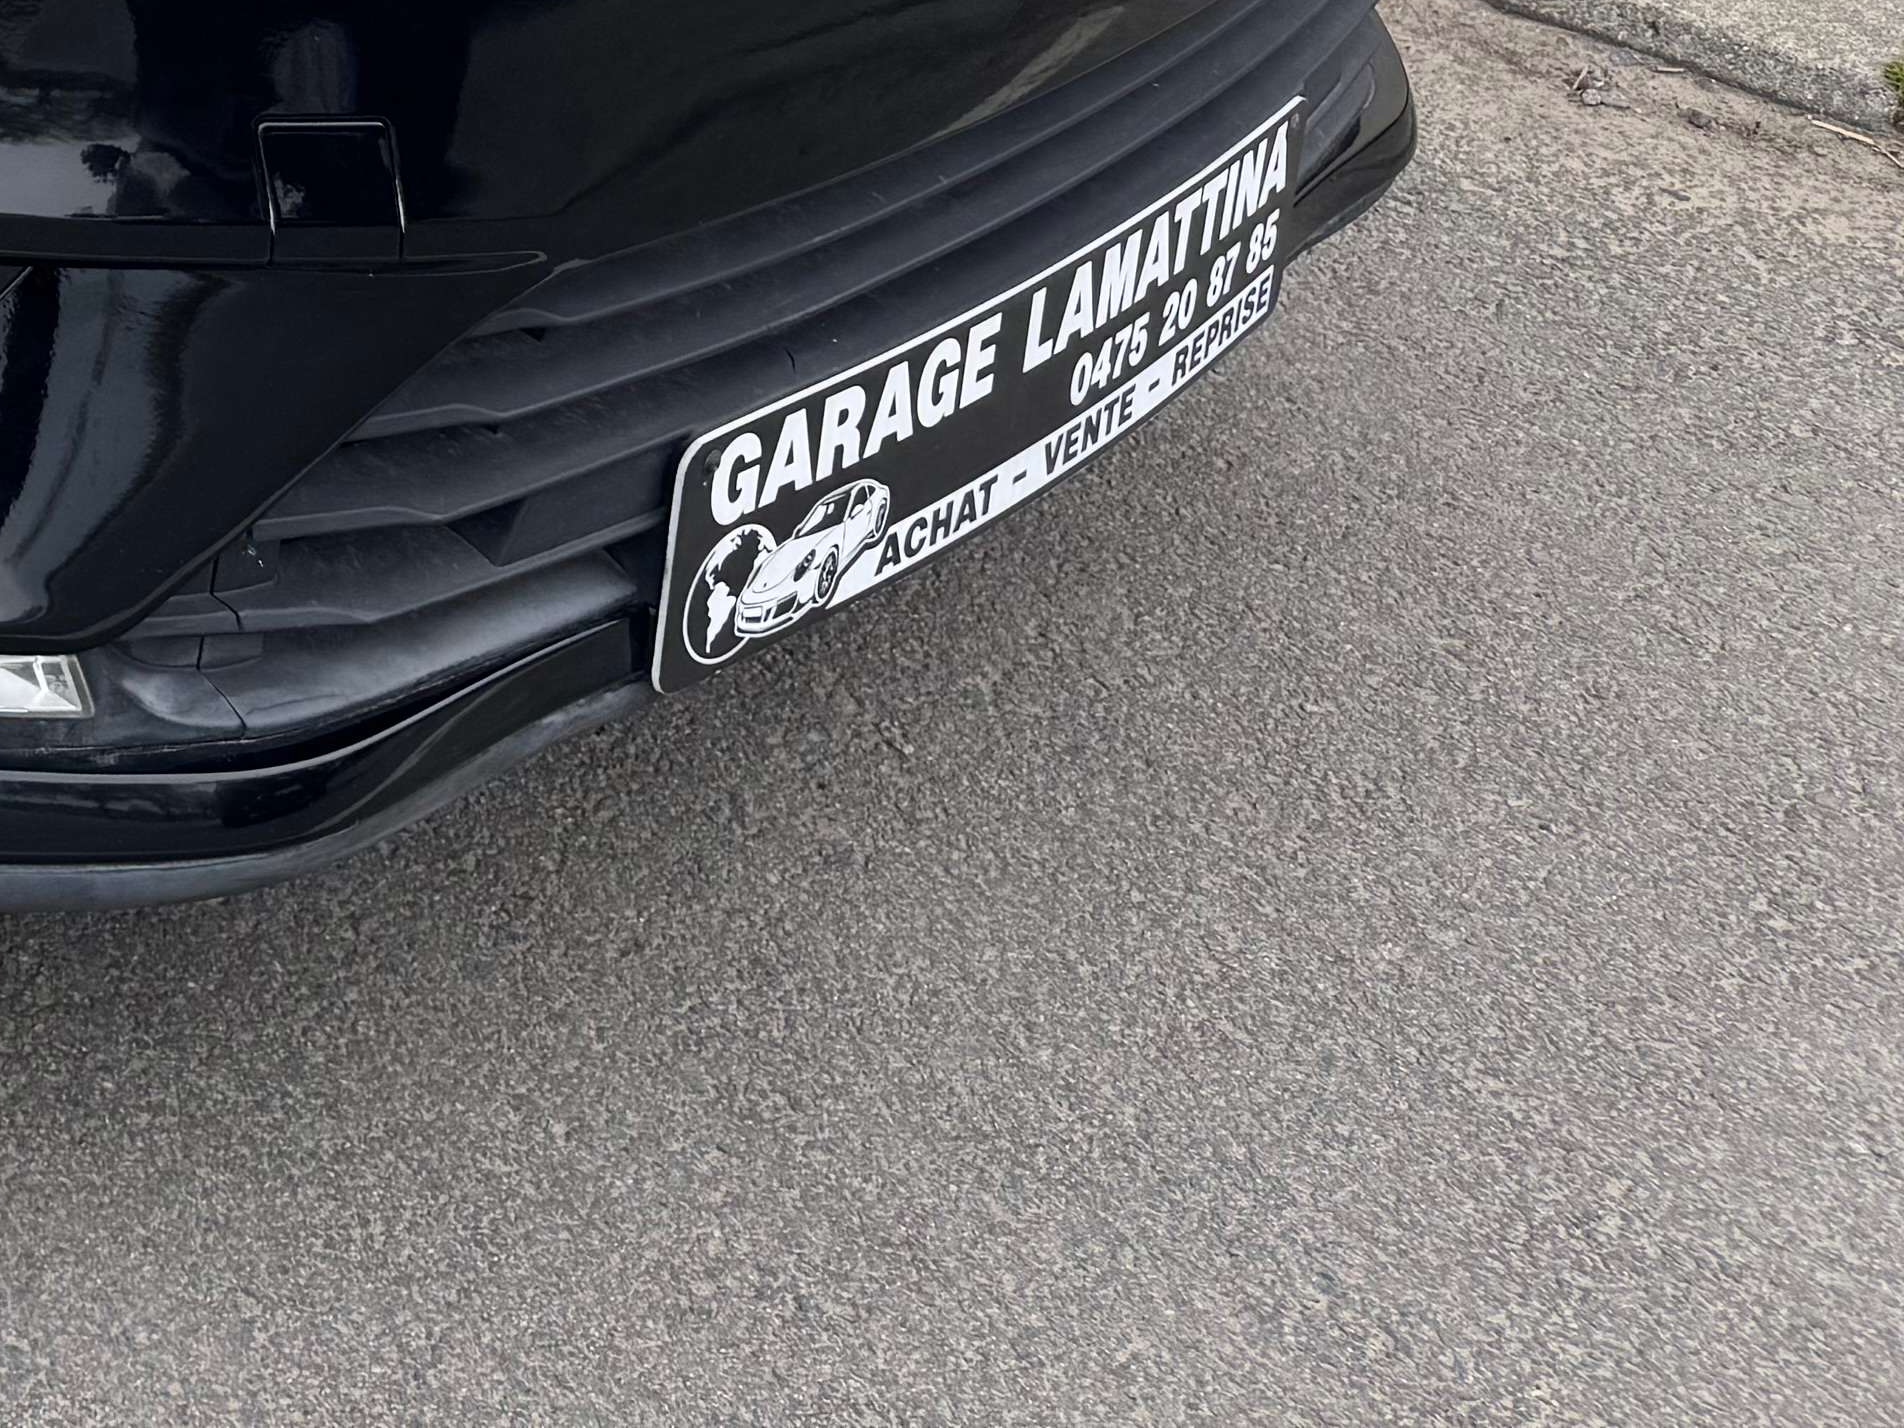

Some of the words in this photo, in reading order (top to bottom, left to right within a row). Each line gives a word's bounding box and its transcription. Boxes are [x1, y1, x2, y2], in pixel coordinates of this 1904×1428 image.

[709, 312, 1003, 526] GARAGE
[1022, 120, 1289, 374] LAMATTINA
[875, 477, 999, 578] ACHAT
[1042, 392, 1137, 477] VENTE
[1169, 277, 1273, 387] REPRISE
[1069, 318, 1149, 406] 0475
[1158, 278, 1199, 346] 20
[1204, 242, 1243, 309] 87
[1244, 207, 1280, 276] 85
